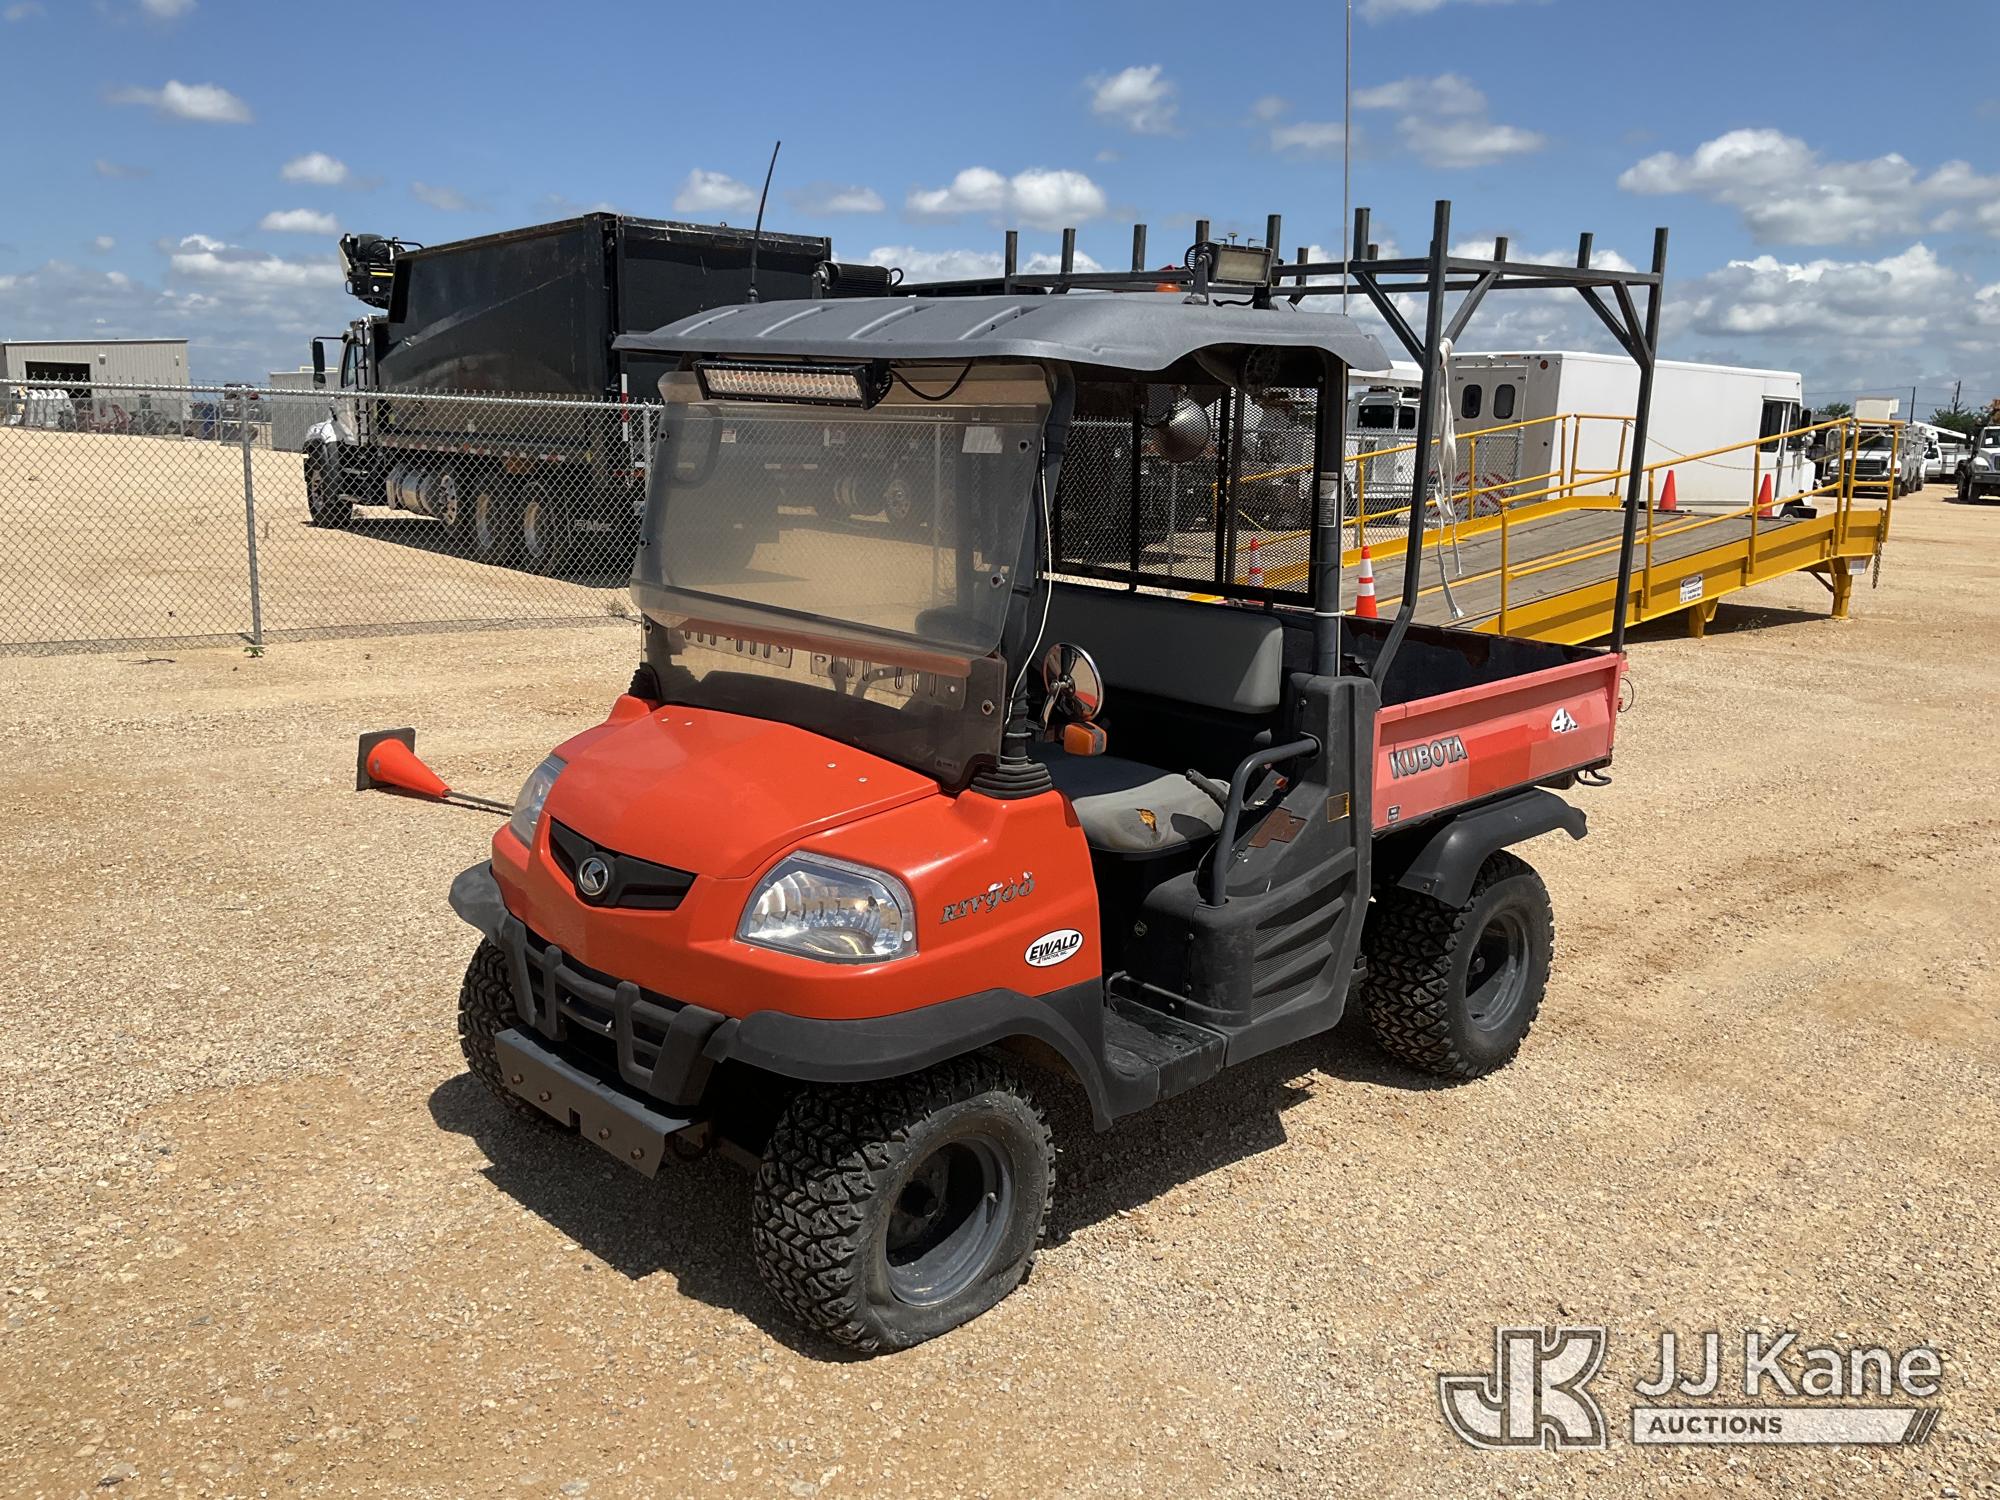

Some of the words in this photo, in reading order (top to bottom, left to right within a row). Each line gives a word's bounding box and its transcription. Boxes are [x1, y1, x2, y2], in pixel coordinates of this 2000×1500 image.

[1389, 735, 1467, 779] KUBOTA
[940, 872, 1035, 924] RTV900
[1029, 933, 1080, 961] EWALD
